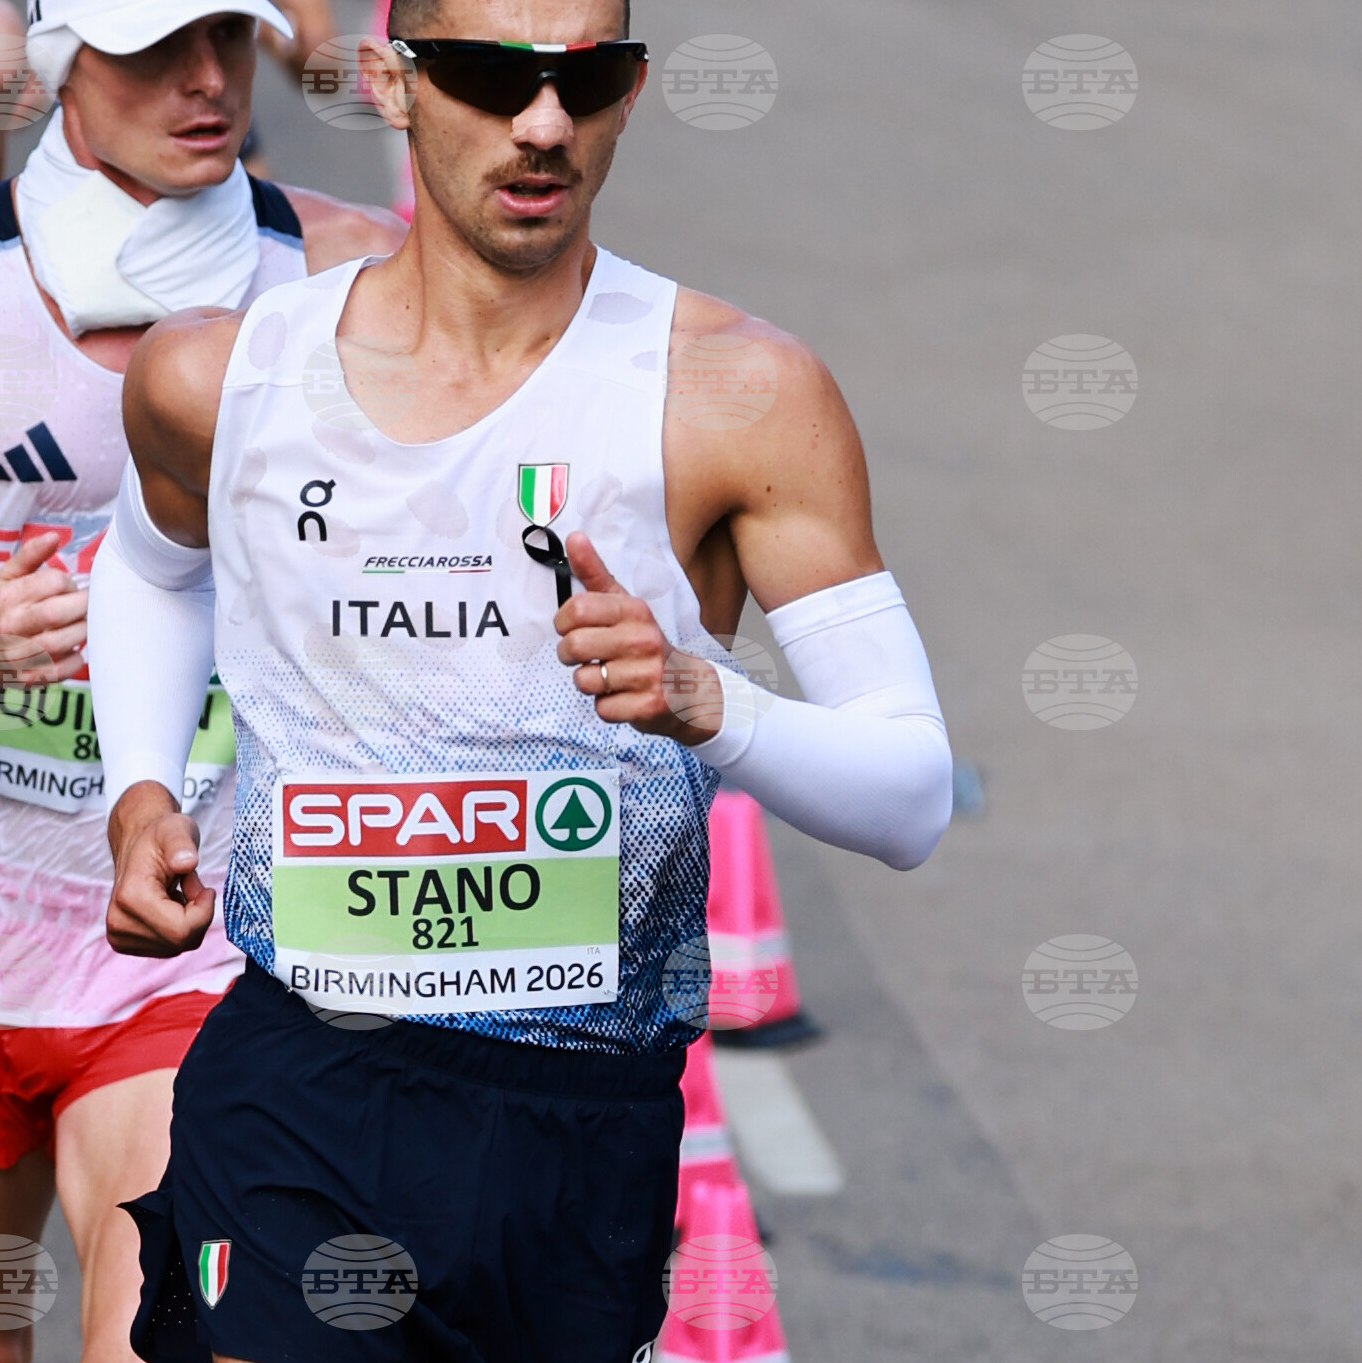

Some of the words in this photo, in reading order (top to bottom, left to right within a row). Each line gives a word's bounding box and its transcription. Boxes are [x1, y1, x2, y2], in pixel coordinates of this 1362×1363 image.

[364, 555, 493, 568] FRECCIAROSSA
[332, 600, 510, 638] ITALIA
[289, 790, 520, 847] SPAR
[347, 863, 541, 917] STANO
[412, 915, 480, 950] 821
[586, 946, 601, 956] ITA
[290, 964, 517, 999] BIRMINGHAM
[526, 961, 605, 993] 2026
